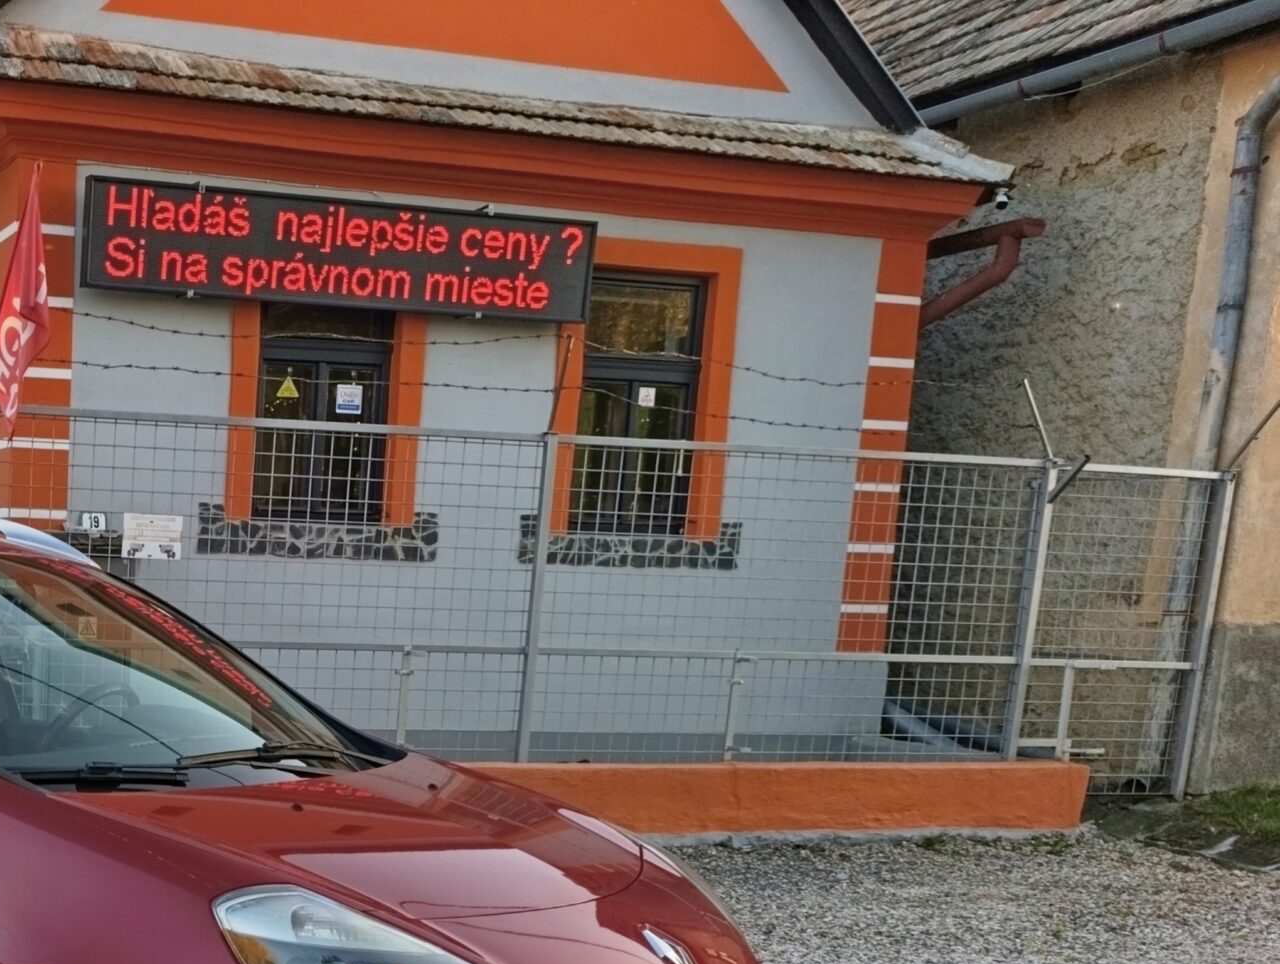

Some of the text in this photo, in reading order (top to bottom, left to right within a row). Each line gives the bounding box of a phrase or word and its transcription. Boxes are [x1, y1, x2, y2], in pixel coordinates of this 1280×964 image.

[107, 185, 584, 271] Hľadáš najlepšie ceny ?
[105, 236, 550, 309] Si na správnom mieste
[89, 515, 100, 529] 19
